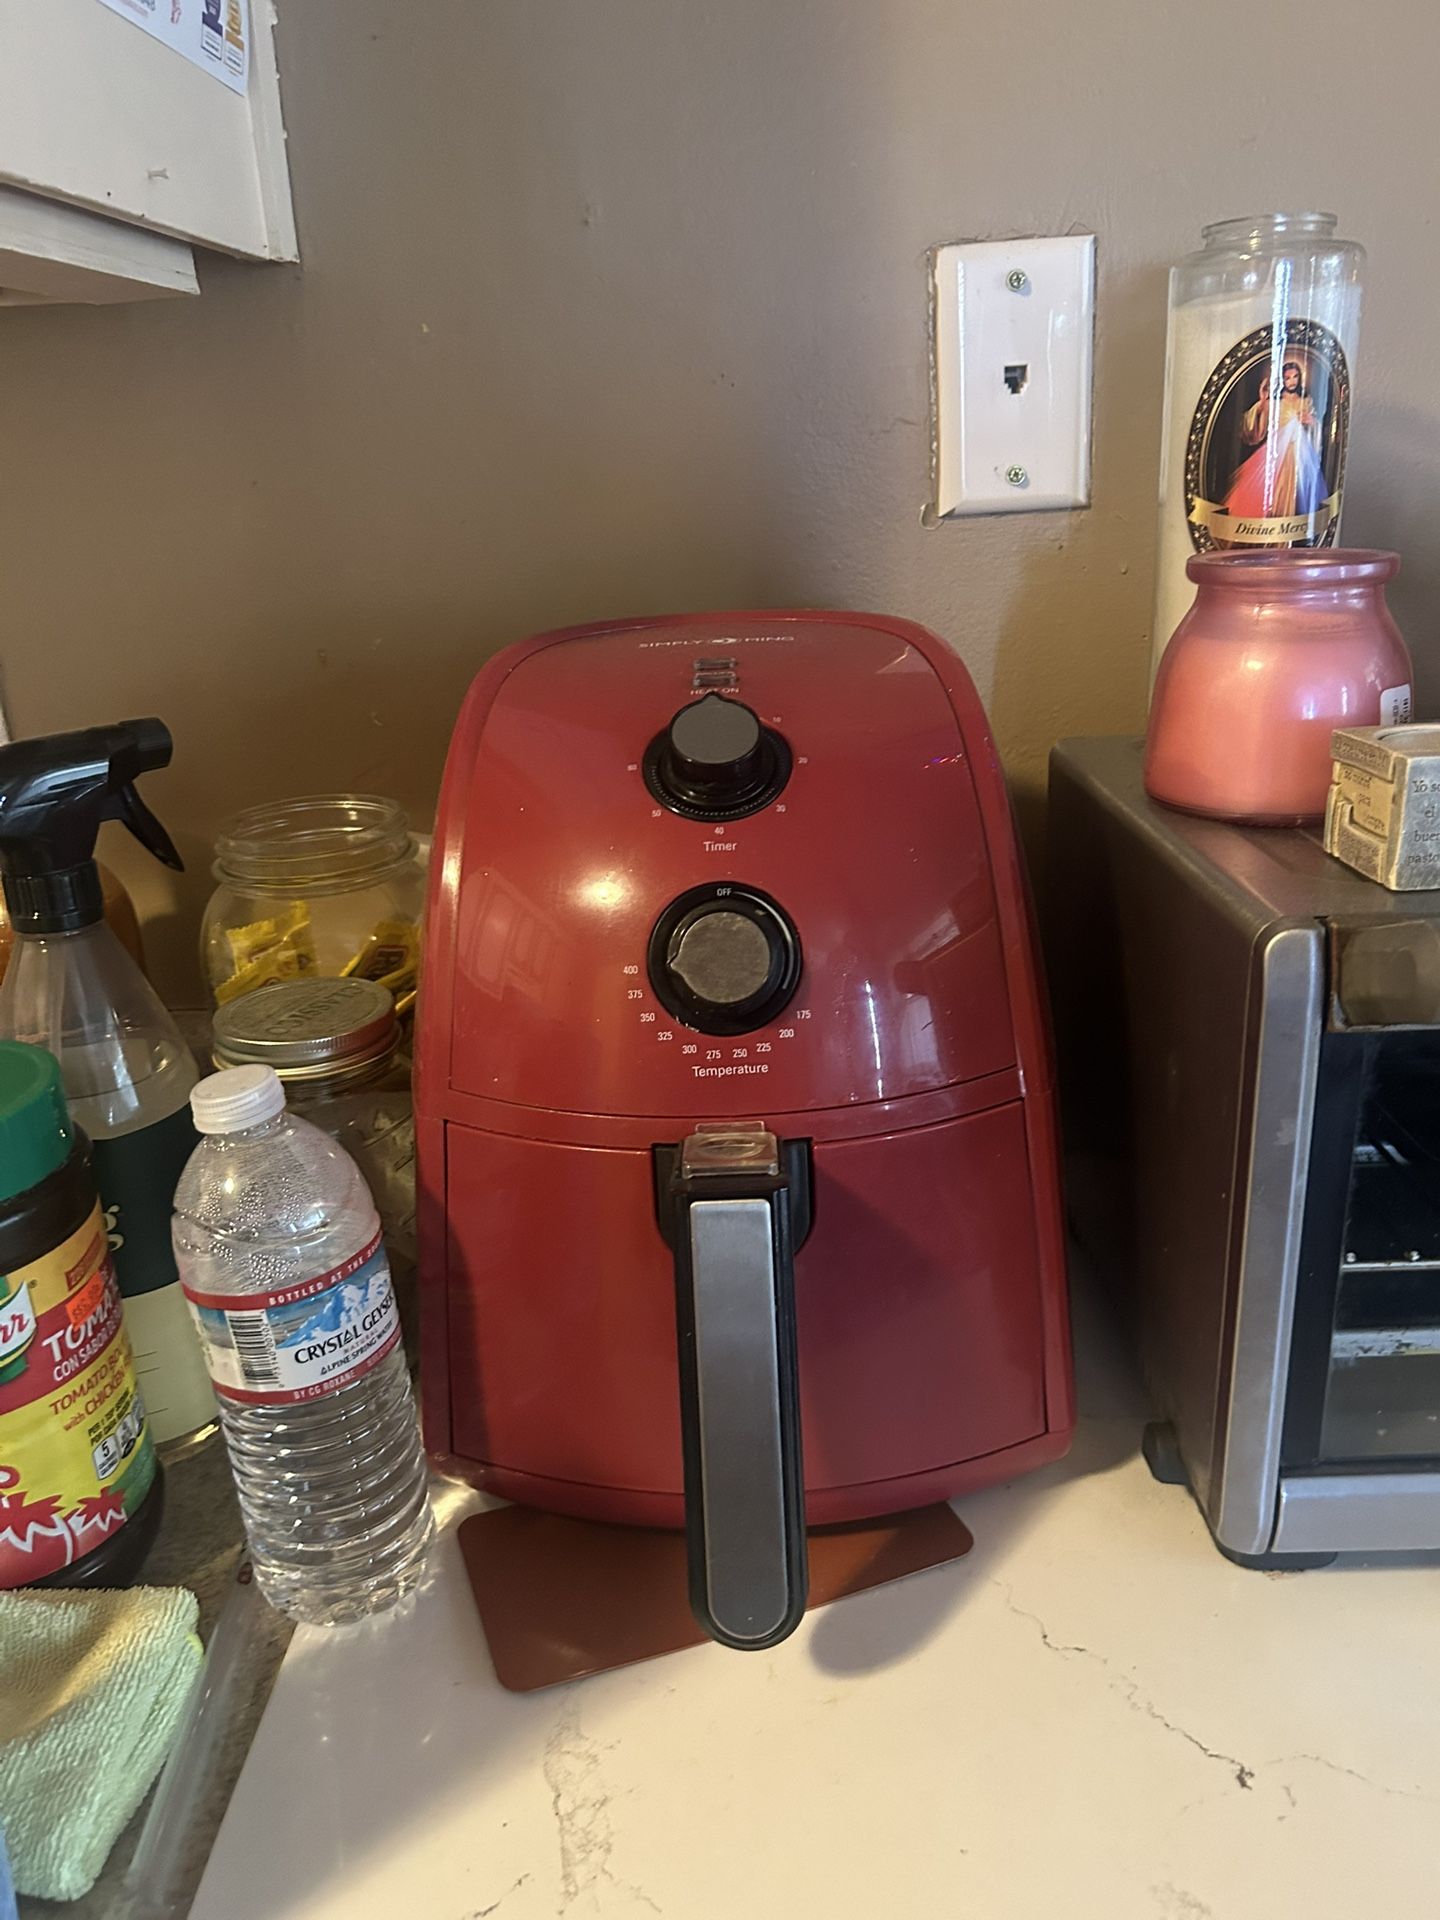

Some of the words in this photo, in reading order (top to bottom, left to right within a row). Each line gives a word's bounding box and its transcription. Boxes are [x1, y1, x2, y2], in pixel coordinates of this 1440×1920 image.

[1234, 522, 1275, 535] Divine
[1412, 779, 1428, 793] Yo
[1430, 783, 1440, 793] so
[651, 809, 662, 818] 50
[714, 826, 725, 835] 40
[703, 840, 738, 852] Timer
[716, 888, 733, 898] OFF
[623, 965, 638, 975] 400
[627, 989, 643, 999] 375
[640, 1012, 656, 1023] 350
[796, 1010, 812, 1019] 175
[657, 1031, 673, 1041] 325
[779, 1028, 795, 1038] 200
[682, 1044, 697, 1054] 300
[756, 1042, 772, 1052] 225
[706, 1050, 721, 1060] 275
[732, 1047, 748, 1058] 250
[692, 1063, 769, 1078] Temperature
[268, 1282, 324, 1306] BOTTLED
[330, 1271, 343, 1284] AT
[347, 1256, 364, 1272] THE
[294, 1324, 362, 1364] CRYSTAL
[53, 1353, 80, 1382] CON
[320, 1353, 351, 1375] ALPINE
[293, 1390, 306, 1400] BY
[101, 1440, 111, 1458] 5
